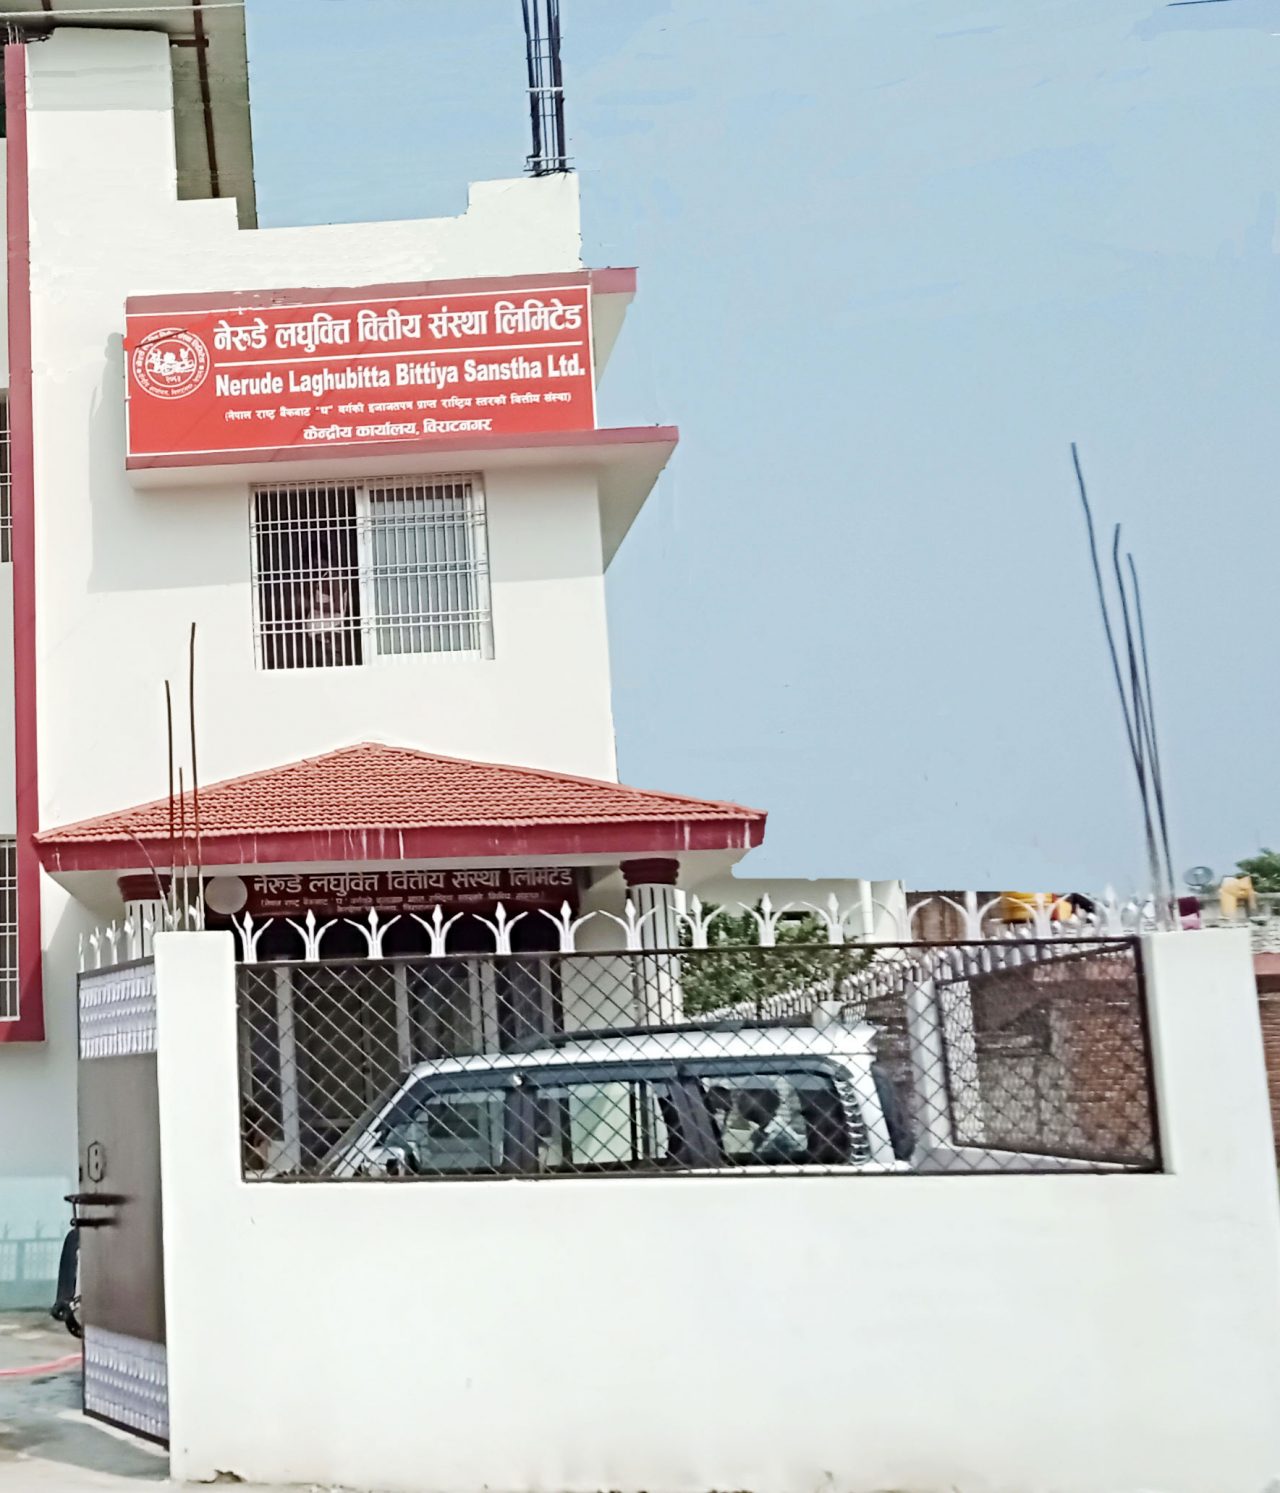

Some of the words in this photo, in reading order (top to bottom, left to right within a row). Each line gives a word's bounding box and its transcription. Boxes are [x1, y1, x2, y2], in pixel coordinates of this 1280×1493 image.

[274, 312, 351, 353] लघुवित्त
[357, 308, 422, 342] वित्तीय
[428, 305, 488, 339] संस्था
[494, 298, 583, 335] लिमिटेड
[215, 371, 284, 397] Nerude
[288, 364, 390, 397] Laghubitta
[395, 360, 459, 390] Bittiya
[463, 356, 543, 383] Sanstha
[547, 353, 586, 377] Ltd.
[303, 424, 352, 441] केन्द्रीय
[423, 417, 493, 434] विराटनगर
